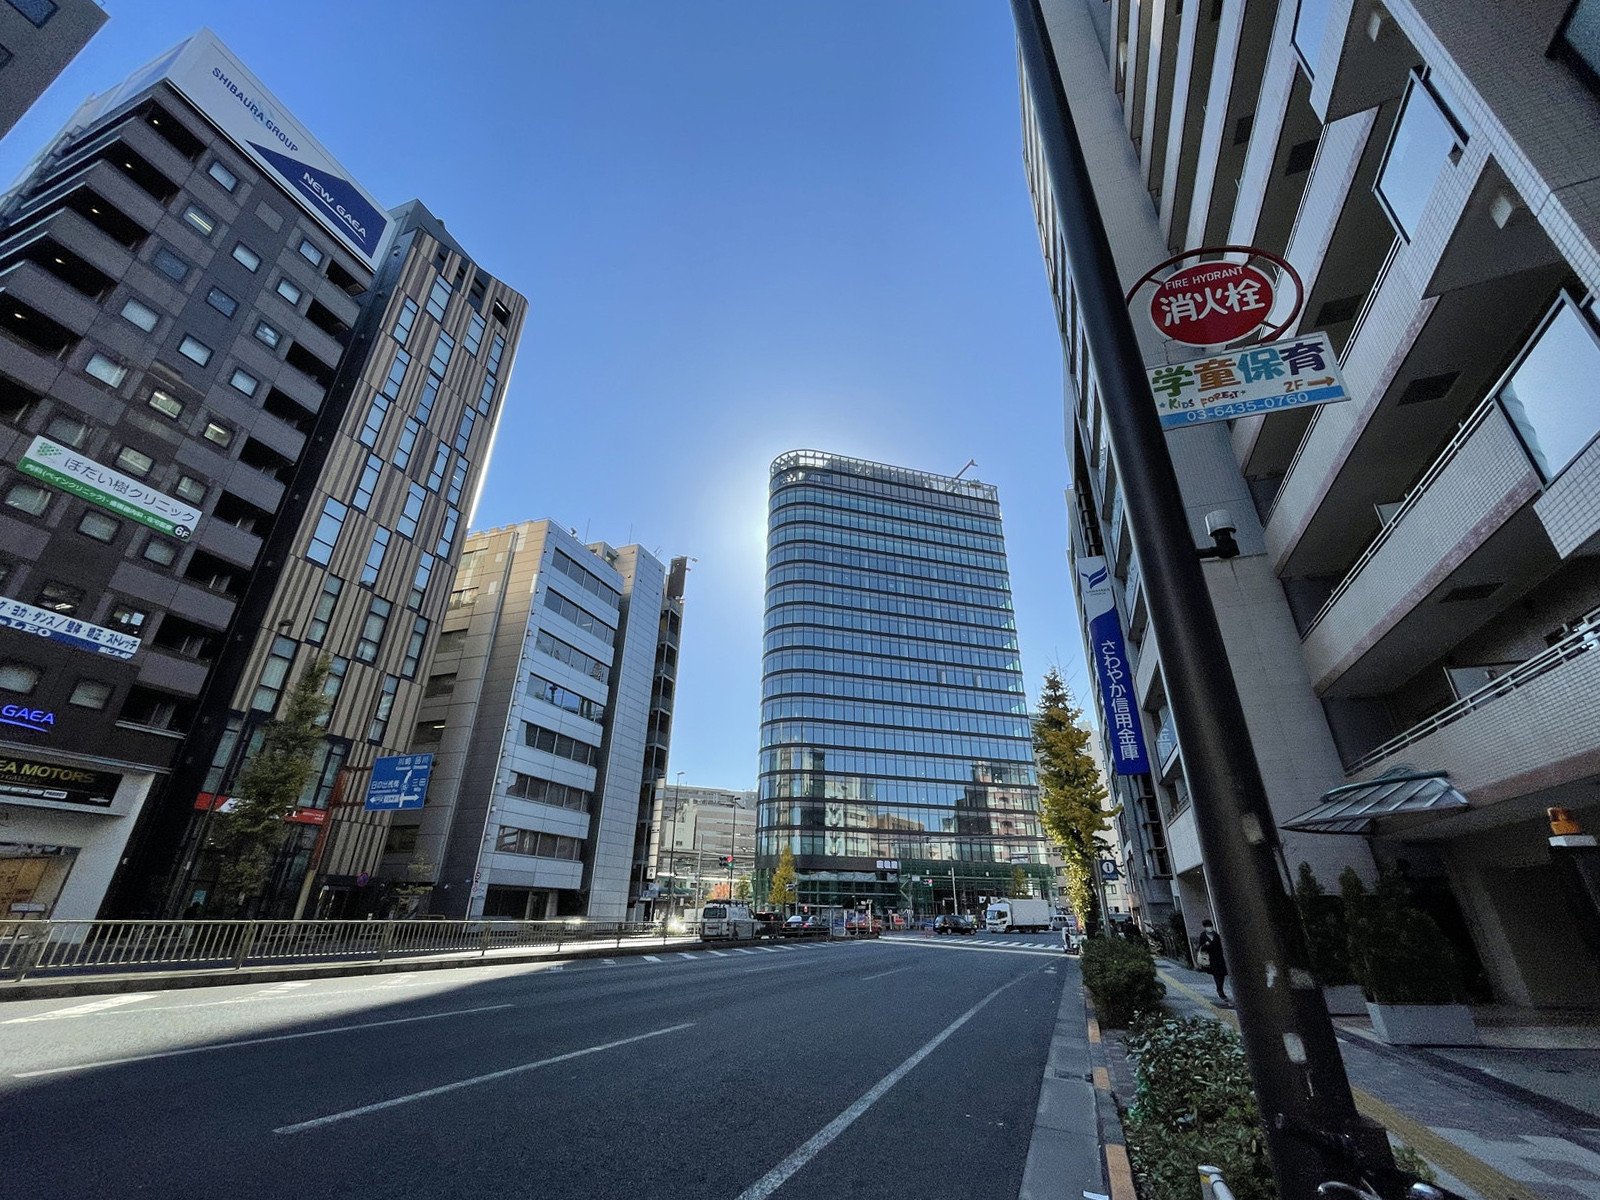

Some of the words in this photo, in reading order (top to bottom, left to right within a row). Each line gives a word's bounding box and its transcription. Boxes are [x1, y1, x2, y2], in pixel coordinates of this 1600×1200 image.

[212, 67, 264, 121] SHIBAURA
[265, 120, 299, 152] GROUP
[303, 172, 335, 204] NEW
[336, 204, 367, 238] GAEA
[1165, 277, 1190, 291] FIRE
[1192, 266, 1244, 285] HYDRANT
[1159, 278, 1266, 327] 消火栓
[1152, 341, 1326, 398] 学童保育
[1283, 379, 1304, 394] 2F
[1186, 393, 1309, 422] 03-6435-0760
[63, 457, 195, 523] ぼだい樹クリニック
[174, 526, 190, 539] 6F
[1, 704, 55, 725] GAEA
[1101, 639, 1140, 761] さわやか信用金庫
[20, 763, 97, 784] MOTORS
